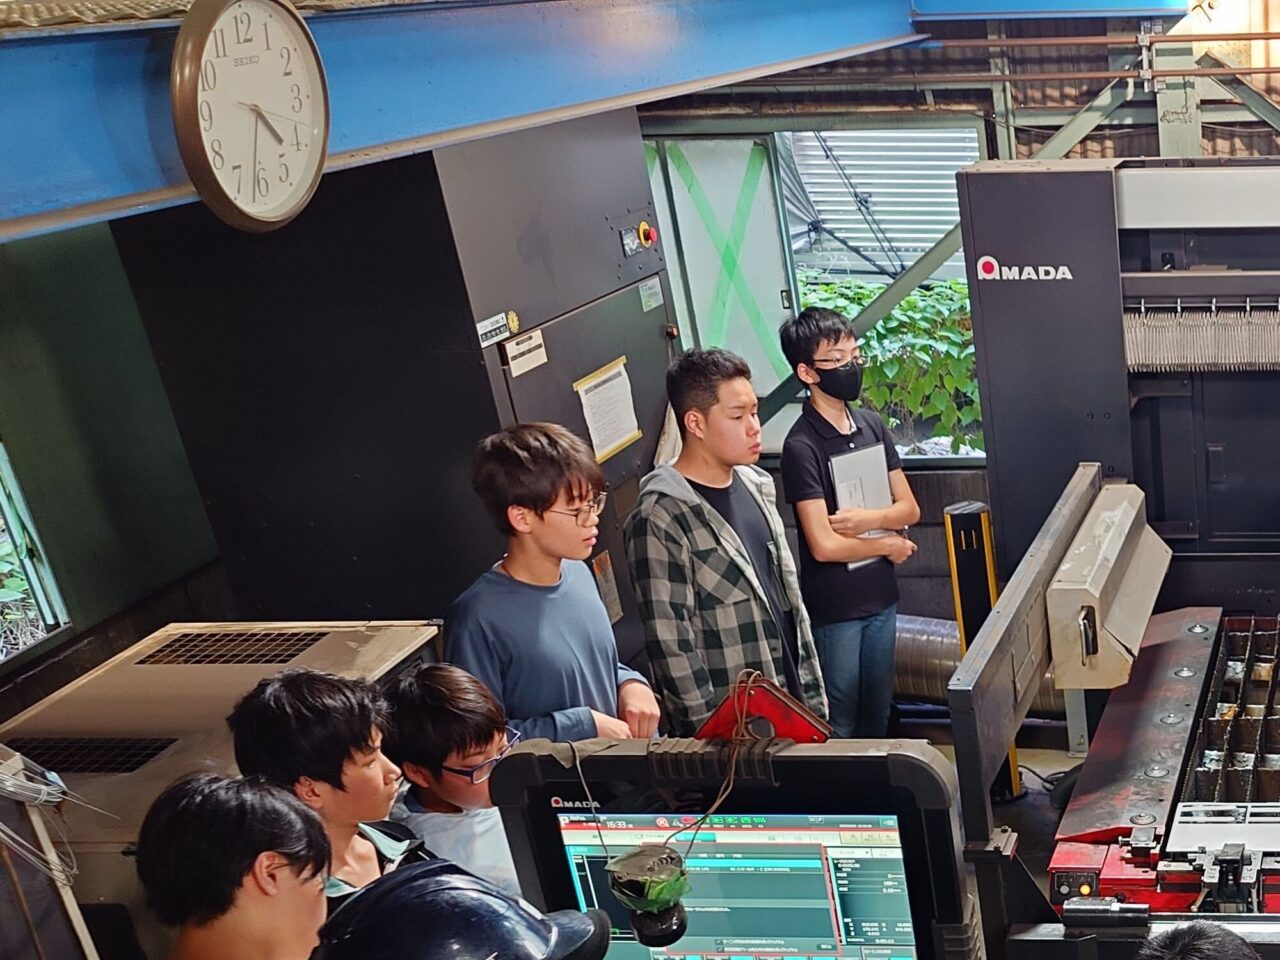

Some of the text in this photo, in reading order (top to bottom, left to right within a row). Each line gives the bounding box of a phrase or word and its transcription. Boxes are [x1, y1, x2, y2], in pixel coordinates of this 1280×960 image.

[212, 28, 228, 59] 11
[233, 12, 253, 45] 12
[262, 22, 271, 51] 1
[200, 59, 217, 92] 10
[233, 55, 260, 67] SEIKO
[280, 47, 292, 77] 2
[291, 84, 302, 113] 3
[200, 100, 212, 132] 9
[290, 123, 302, 152] 4
[211, 139, 224, 170] 8
[278, 153, 289, 183] 5
[231, 164, 242, 195] 7
[256, 168, 269, 198] 6
[977, 255, 1073, 280] AMADA
[551, 796, 601, 808] AMADA
